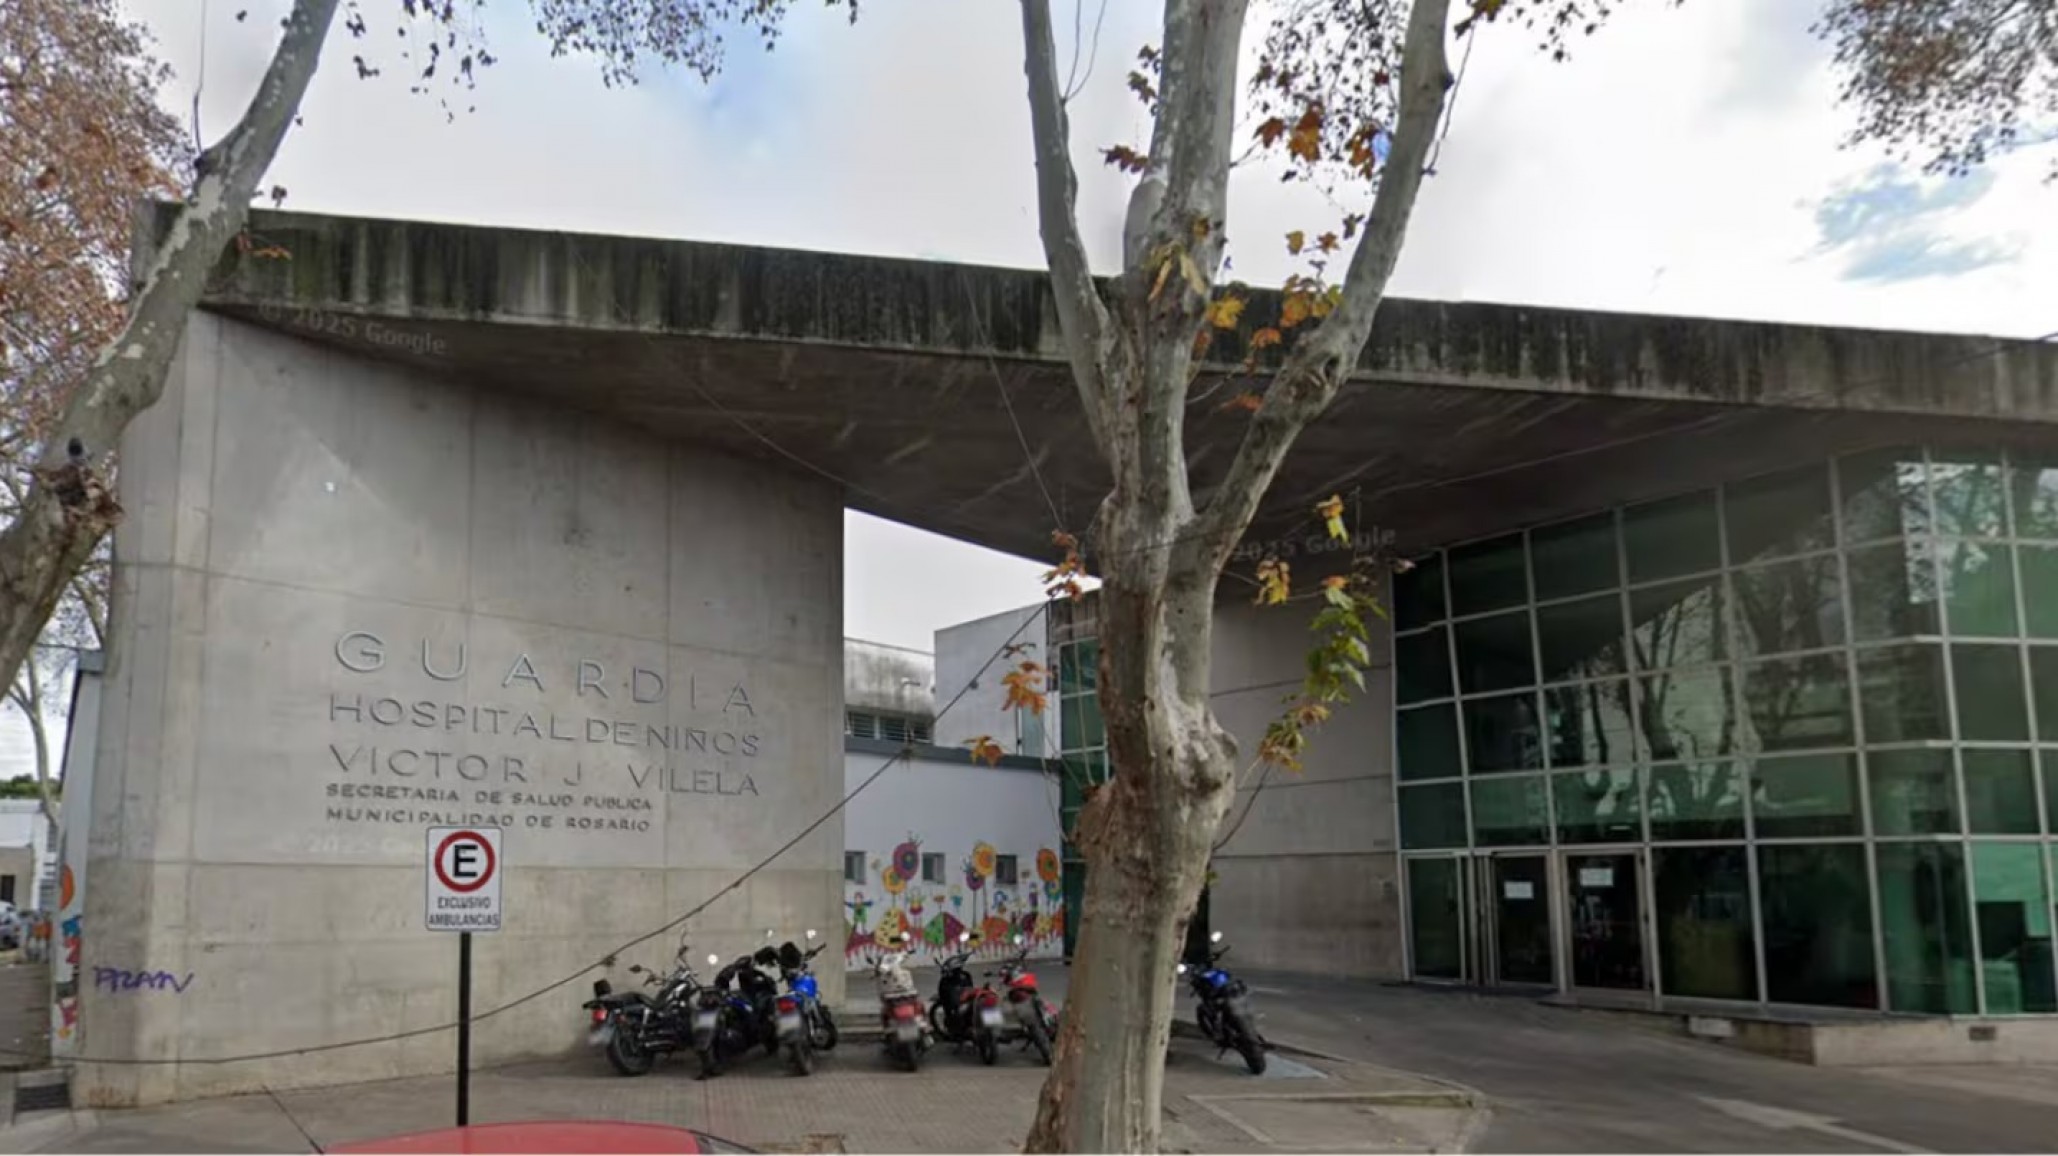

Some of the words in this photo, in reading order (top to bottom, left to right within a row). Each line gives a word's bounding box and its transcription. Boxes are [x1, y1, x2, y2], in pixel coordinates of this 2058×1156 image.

[334, 630, 756, 717] GUARDIA
[329, 694, 575, 742] HOSPITAL
[585, 717, 638, 746] DE
[646, 725, 760, 758] NIÑOS
[329, 743, 528, 783] VICTOR
[563, 762, 582, 786] J
[626, 763, 760, 797] VILELA
[325, 782, 460, 803] SECRETARIA
[475, 789, 502, 805] DE
[511, 791, 575, 808] SALUD
[583, 795, 653, 812] PUBLICA
[326, 807, 514, 828] MUNICIPALIDAD
[525, 814, 553, 829] DE
[565, 817, 650, 833] ROSARIO
[453, 844, 479, 878] E
[437, 896, 492, 910] EXCLUSIVO
[428, 914, 501, 926] AMBULANCIAS
